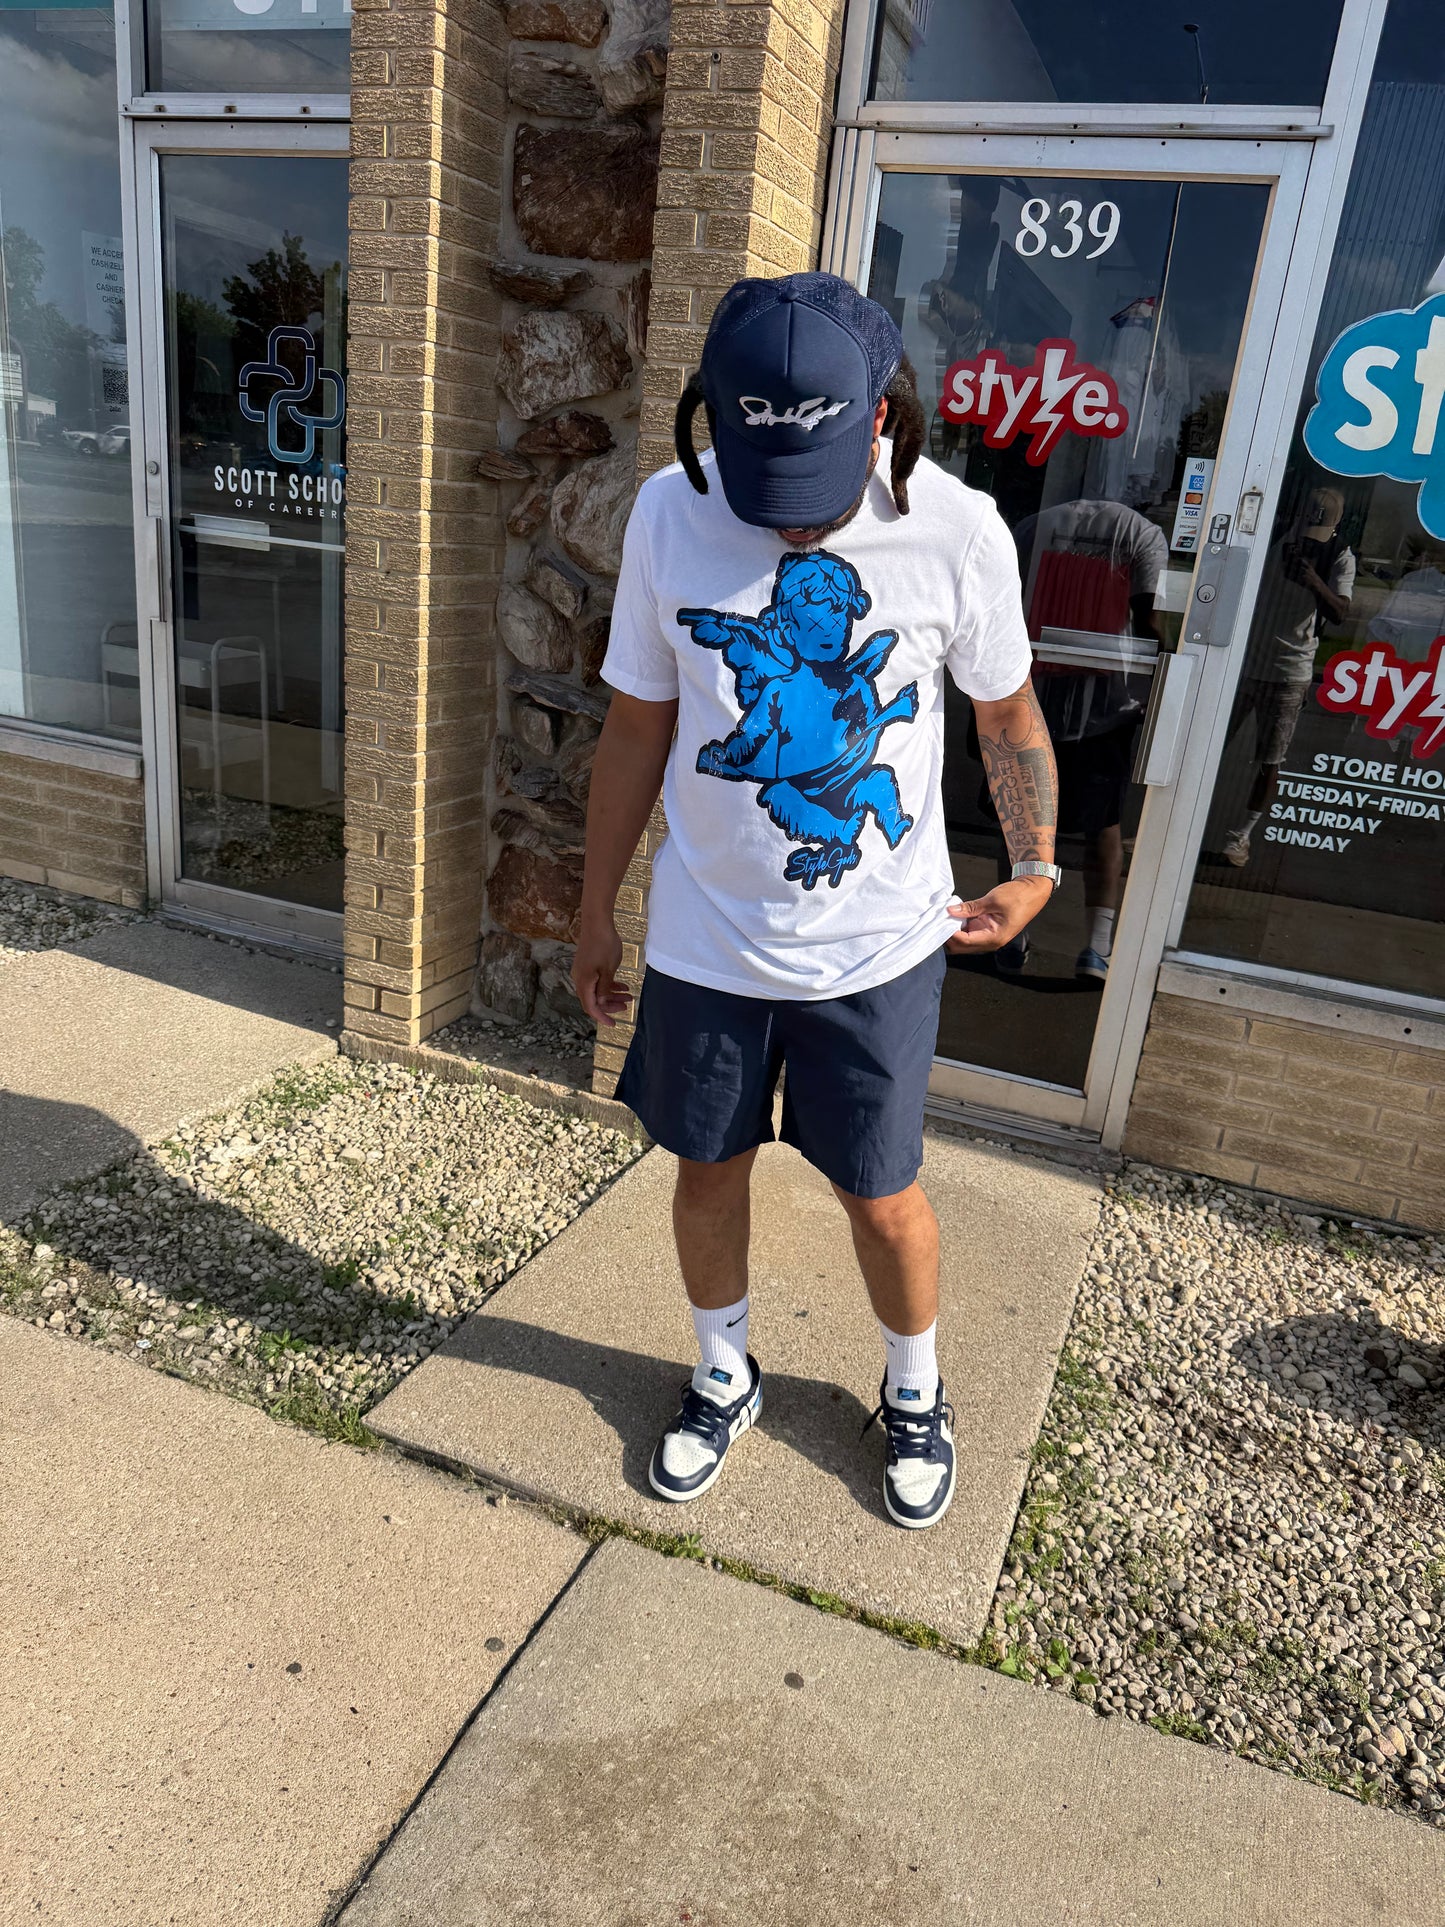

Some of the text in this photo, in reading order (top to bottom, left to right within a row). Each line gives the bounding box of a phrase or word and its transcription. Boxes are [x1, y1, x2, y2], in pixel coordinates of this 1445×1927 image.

[1015, 198, 1121, 260] 839
[91, 246, 101, 255] WE
[104, 273, 118, 282] AND
[214, 465, 342, 505] SCOTT SCHO
[235, 498, 254, 509] OF
[1184, 509, 1198, 517] VISA
[1312, 753, 1445, 791] STORE HO
[1269, 803, 1382, 835] SATURDAY
[1264, 827, 1351, 853] SUNDAY
